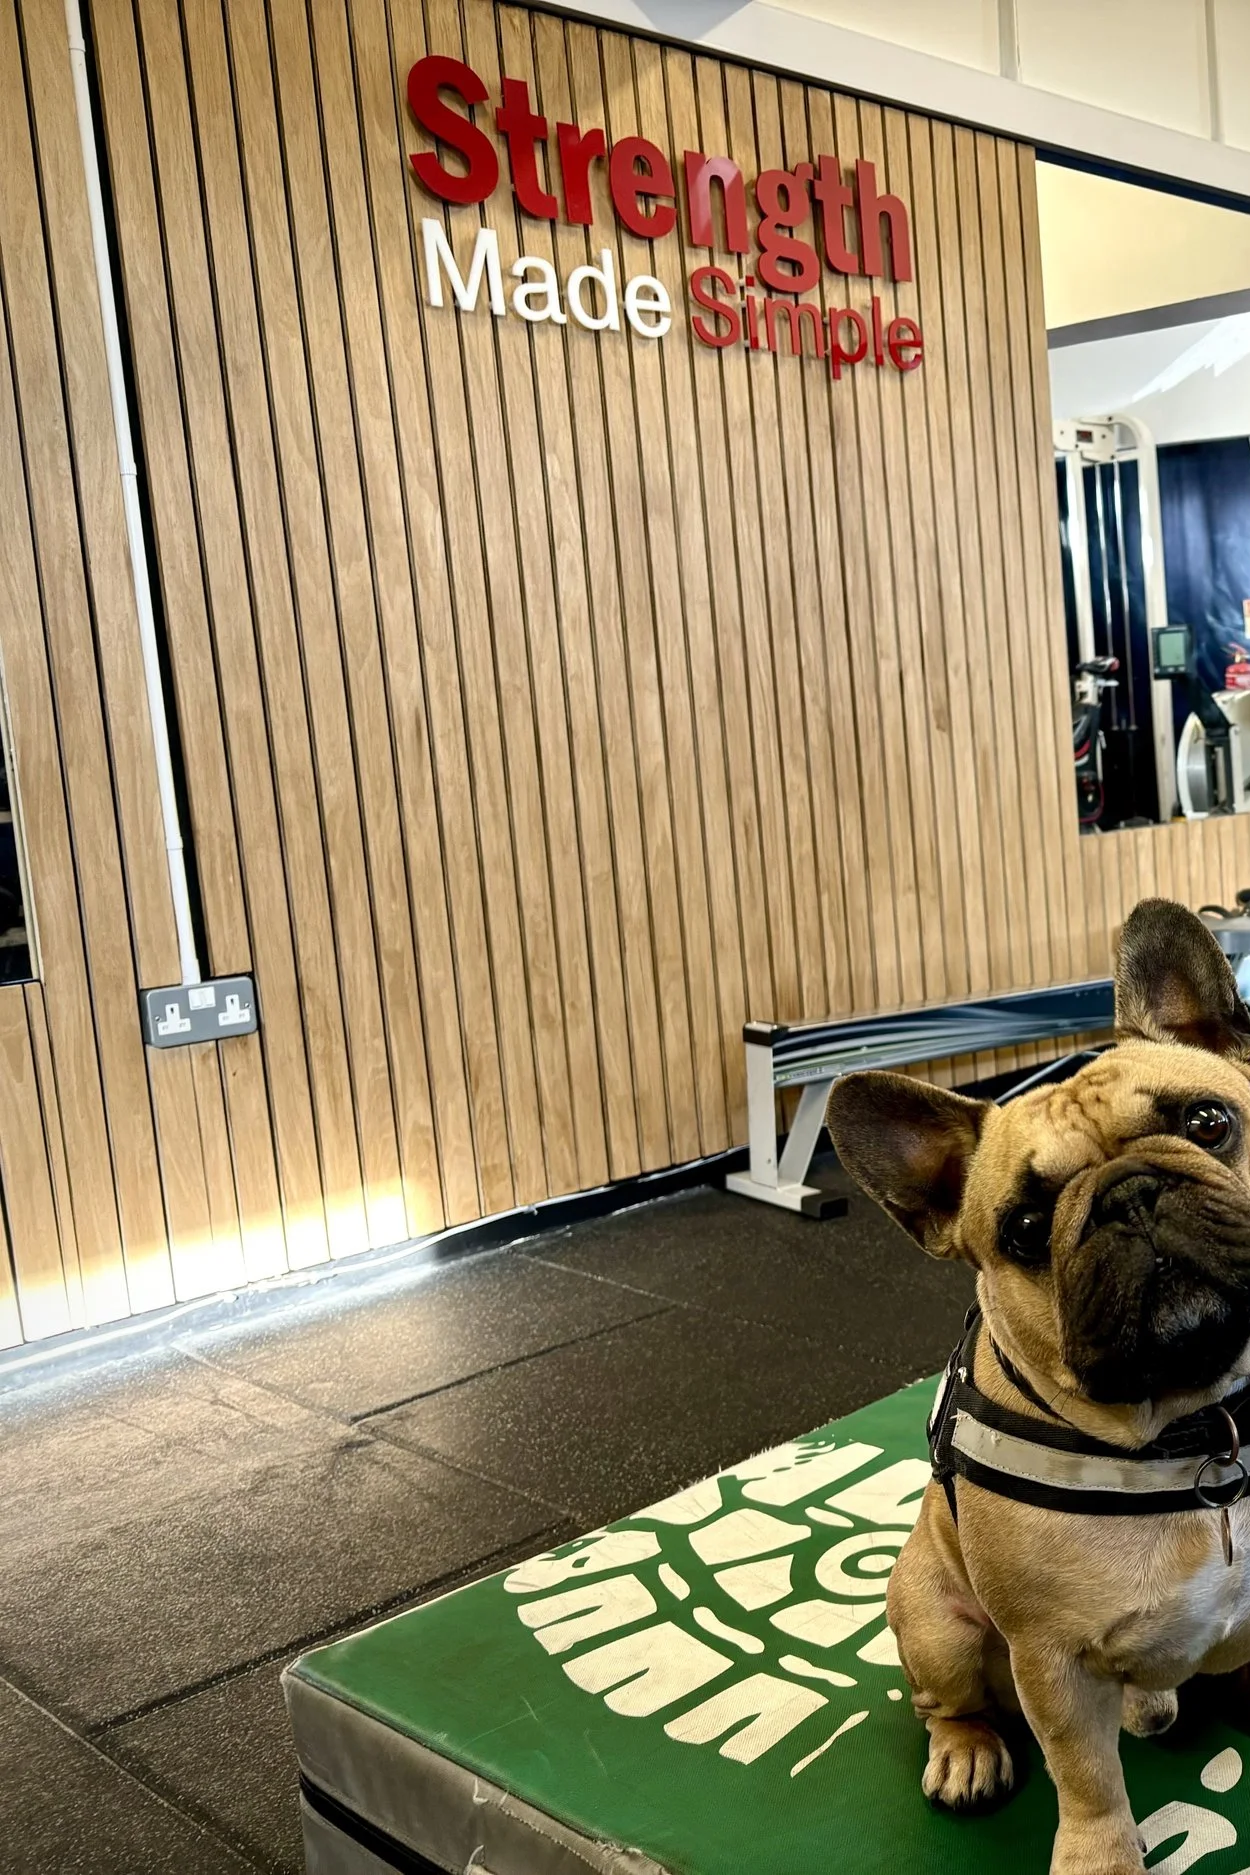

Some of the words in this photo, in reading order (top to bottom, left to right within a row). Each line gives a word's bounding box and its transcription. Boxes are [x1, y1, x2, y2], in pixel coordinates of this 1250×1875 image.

[407, 55, 912, 293] Strength
[421, 218, 672, 338] Made
[691, 266, 924, 380] Simple
